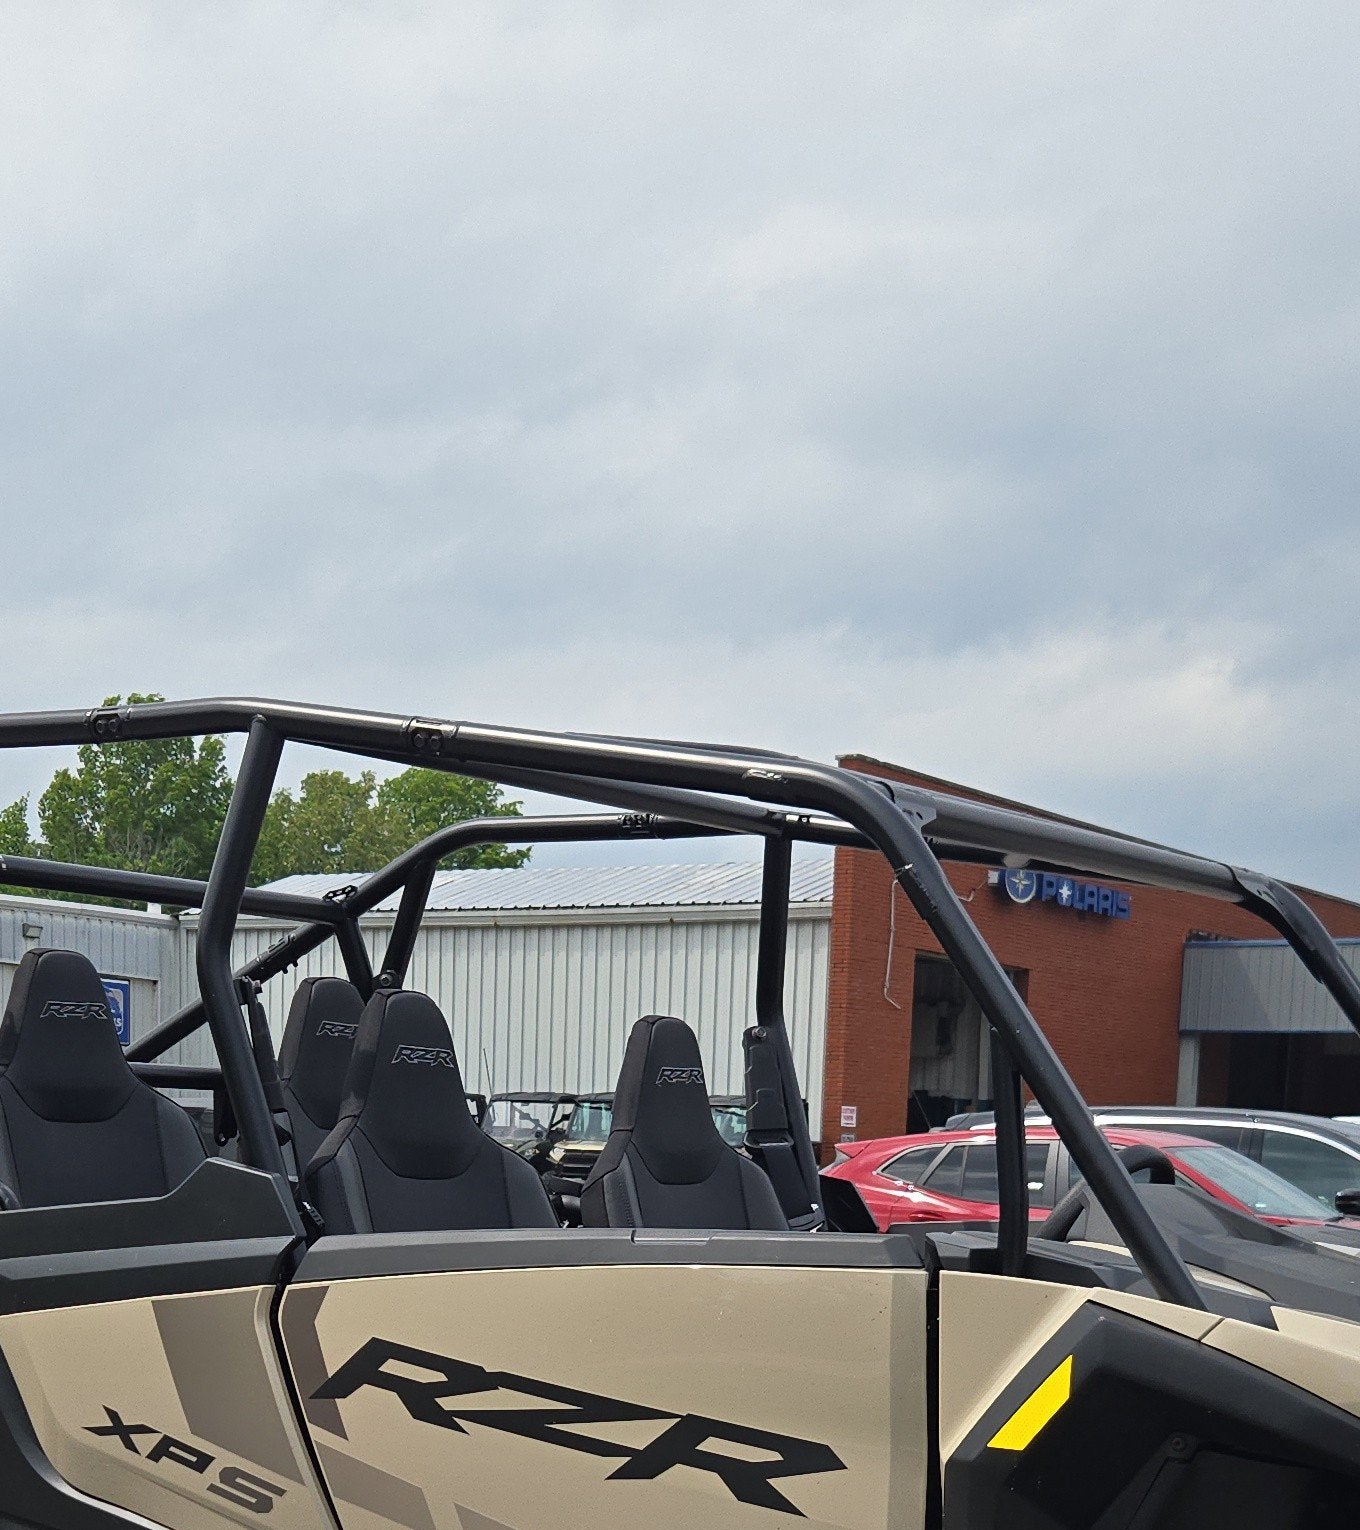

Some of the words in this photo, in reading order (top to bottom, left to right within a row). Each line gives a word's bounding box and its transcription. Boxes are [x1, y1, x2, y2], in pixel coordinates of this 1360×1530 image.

[1042, 874, 1131, 919] POLARIS
[40, 1001, 107, 1019] RZR
[316, 1021, 359, 1039] RZ
[391, 1045, 454, 1069] RZR
[656, 1066, 703, 1084] RZR
[308, 1336, 848, 1518] RZR
[81, 1404, 288, 1514] XPS
